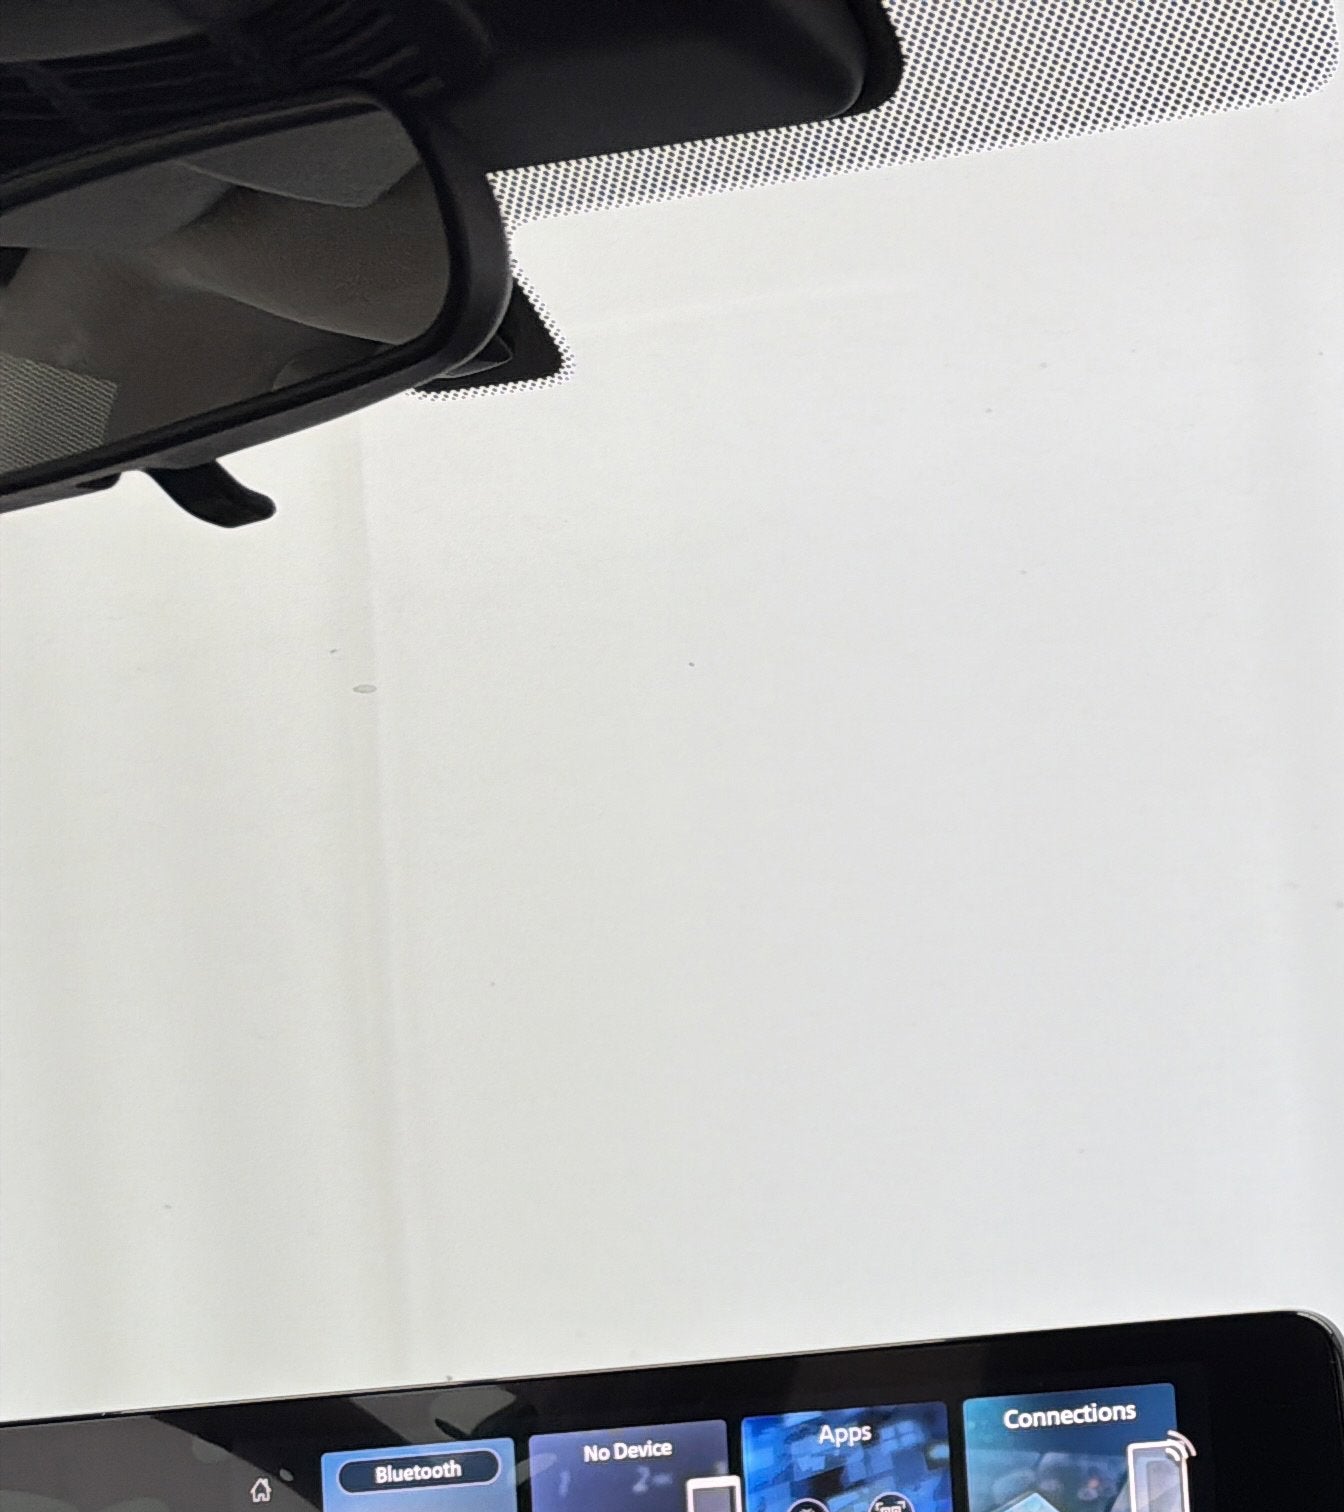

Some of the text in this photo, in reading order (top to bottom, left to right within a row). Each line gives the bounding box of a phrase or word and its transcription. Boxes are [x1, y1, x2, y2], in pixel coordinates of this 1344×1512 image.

[1003, 1401, 1137, 1429] Connections
[818, 1423, 873, 1447] Apps
[583, 1440, 673, 1463] No Device
[375, 1460, 462, 1484] Bluetooth
